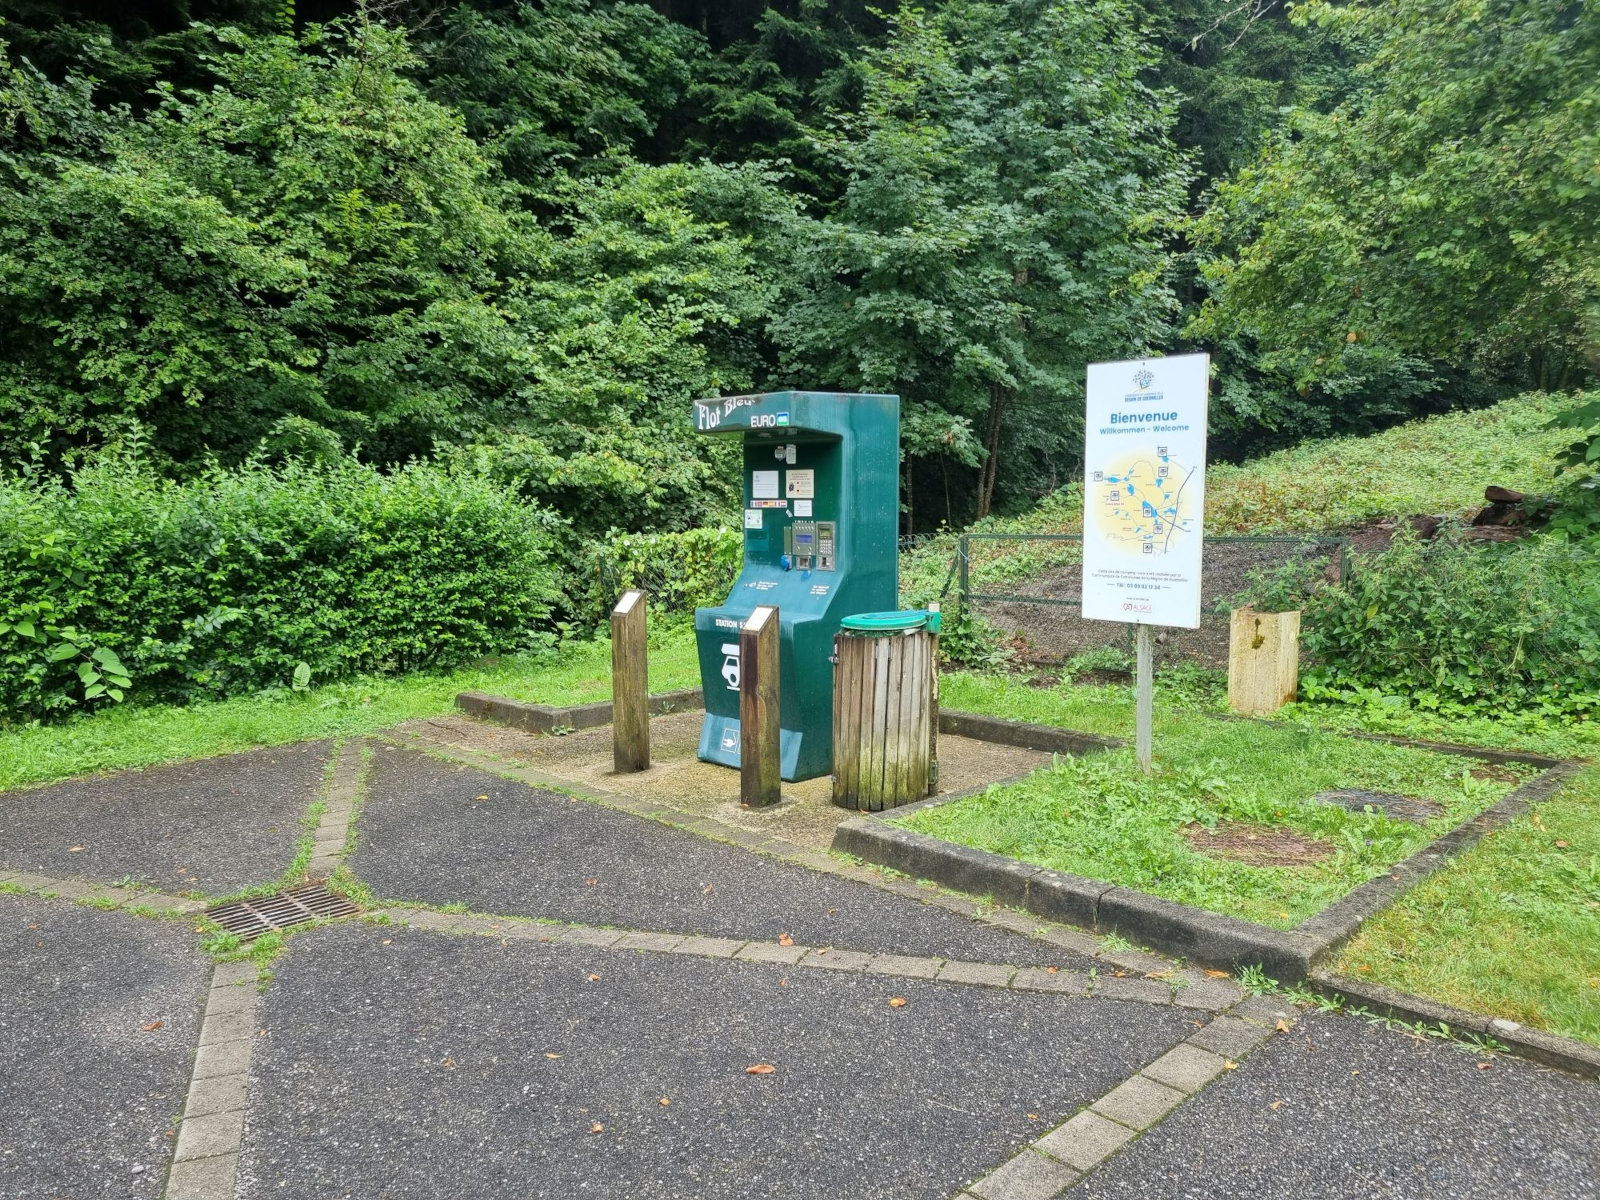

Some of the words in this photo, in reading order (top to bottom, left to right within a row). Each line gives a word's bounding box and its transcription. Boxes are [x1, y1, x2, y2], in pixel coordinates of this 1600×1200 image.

[750, 414, 776, 428] EURO
[1110, 411, 1178, 424] Bienvenue
[1099, 426, 1146, 435] Willkommen
[1152, 424, 1190, 432] Welcome
[715, 618, 738, 628] STATION
